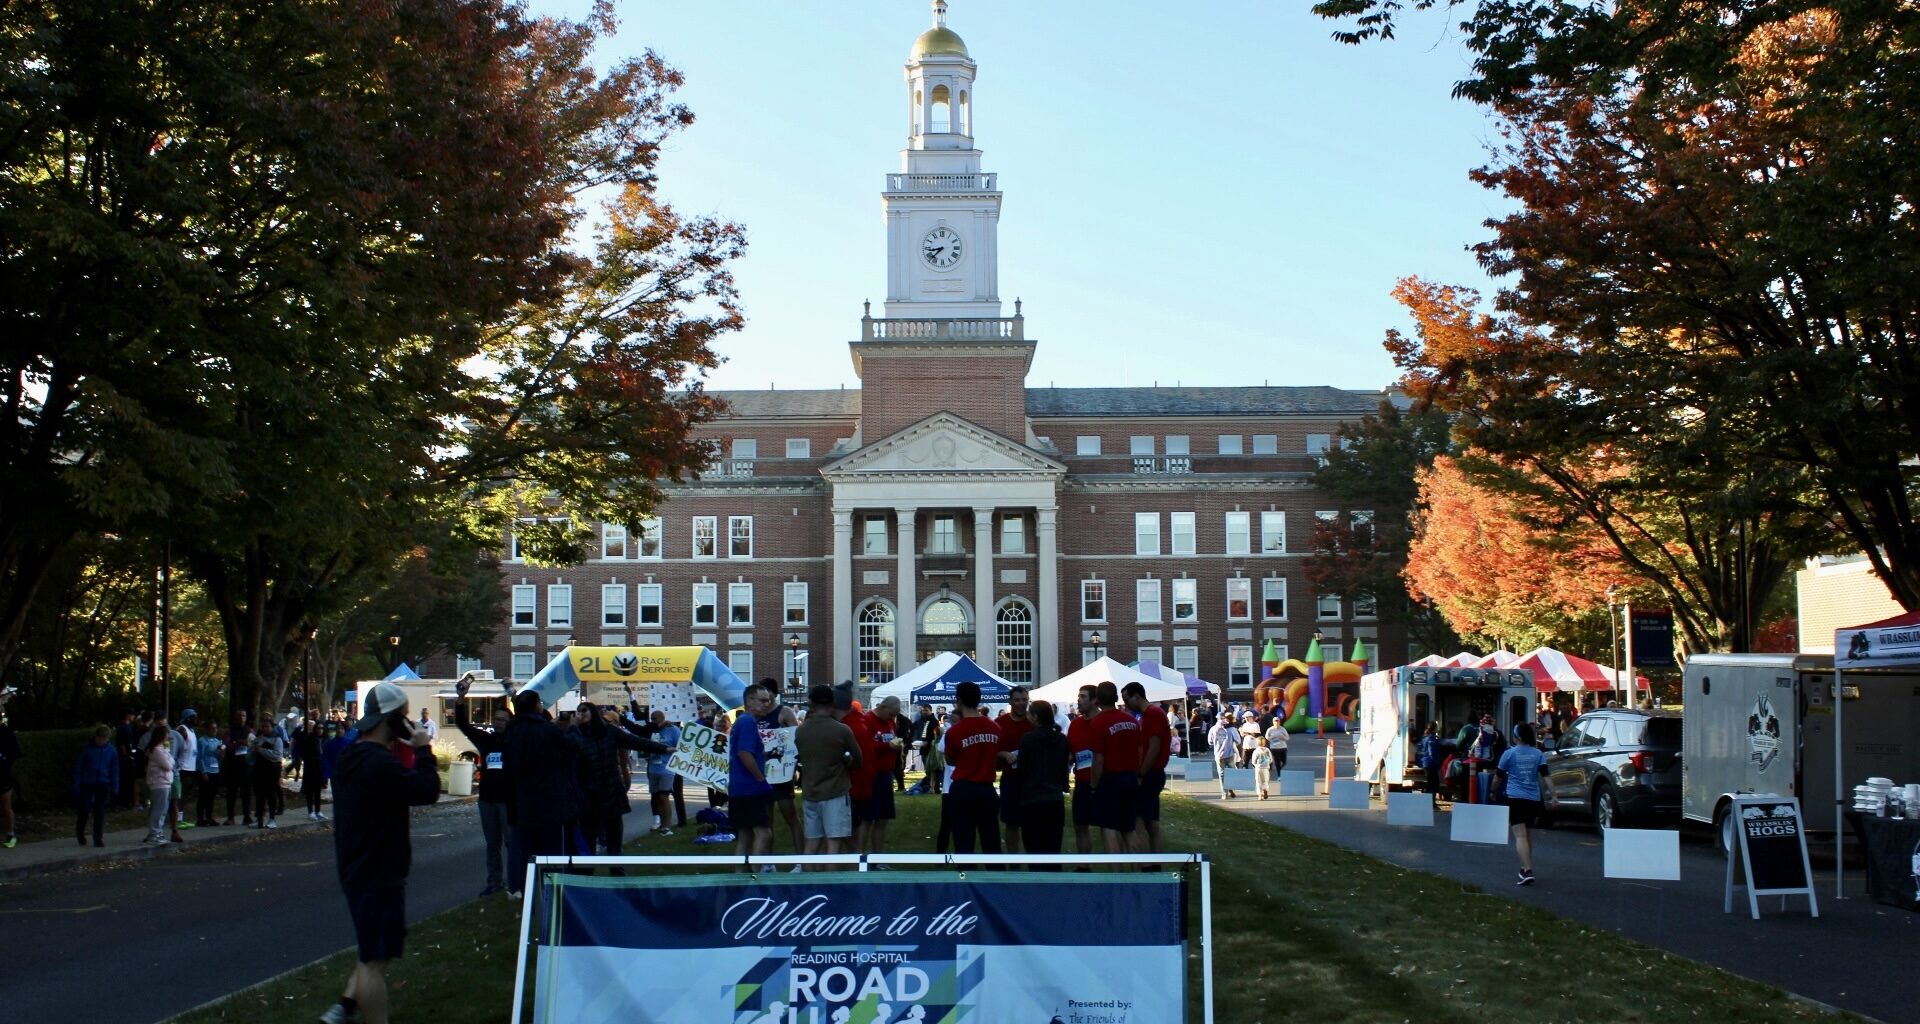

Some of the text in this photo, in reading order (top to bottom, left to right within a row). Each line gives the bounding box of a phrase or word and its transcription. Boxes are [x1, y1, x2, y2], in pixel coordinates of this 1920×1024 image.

[579, 656, 610, 673] 2L
[641, 657, 671, 665] RACE
[641, 666, 689, 674] SERVICES
[682, 721, 712, 748] GO
[961, 733, 999, 748] RECRUIT
[1748, 825, 1796, 836] HOGS
[721, 894, 979, 940] Welcome to the
[791, 952, 911, 965] READING HOSPITAL
[789, 966, 930, 1003] ROAD
[1068, 1000, 1132, 1010] Presented by:
[1068, 1012, 1083, 1024] The
[1087, 1012, 1116, 1024] Friends
